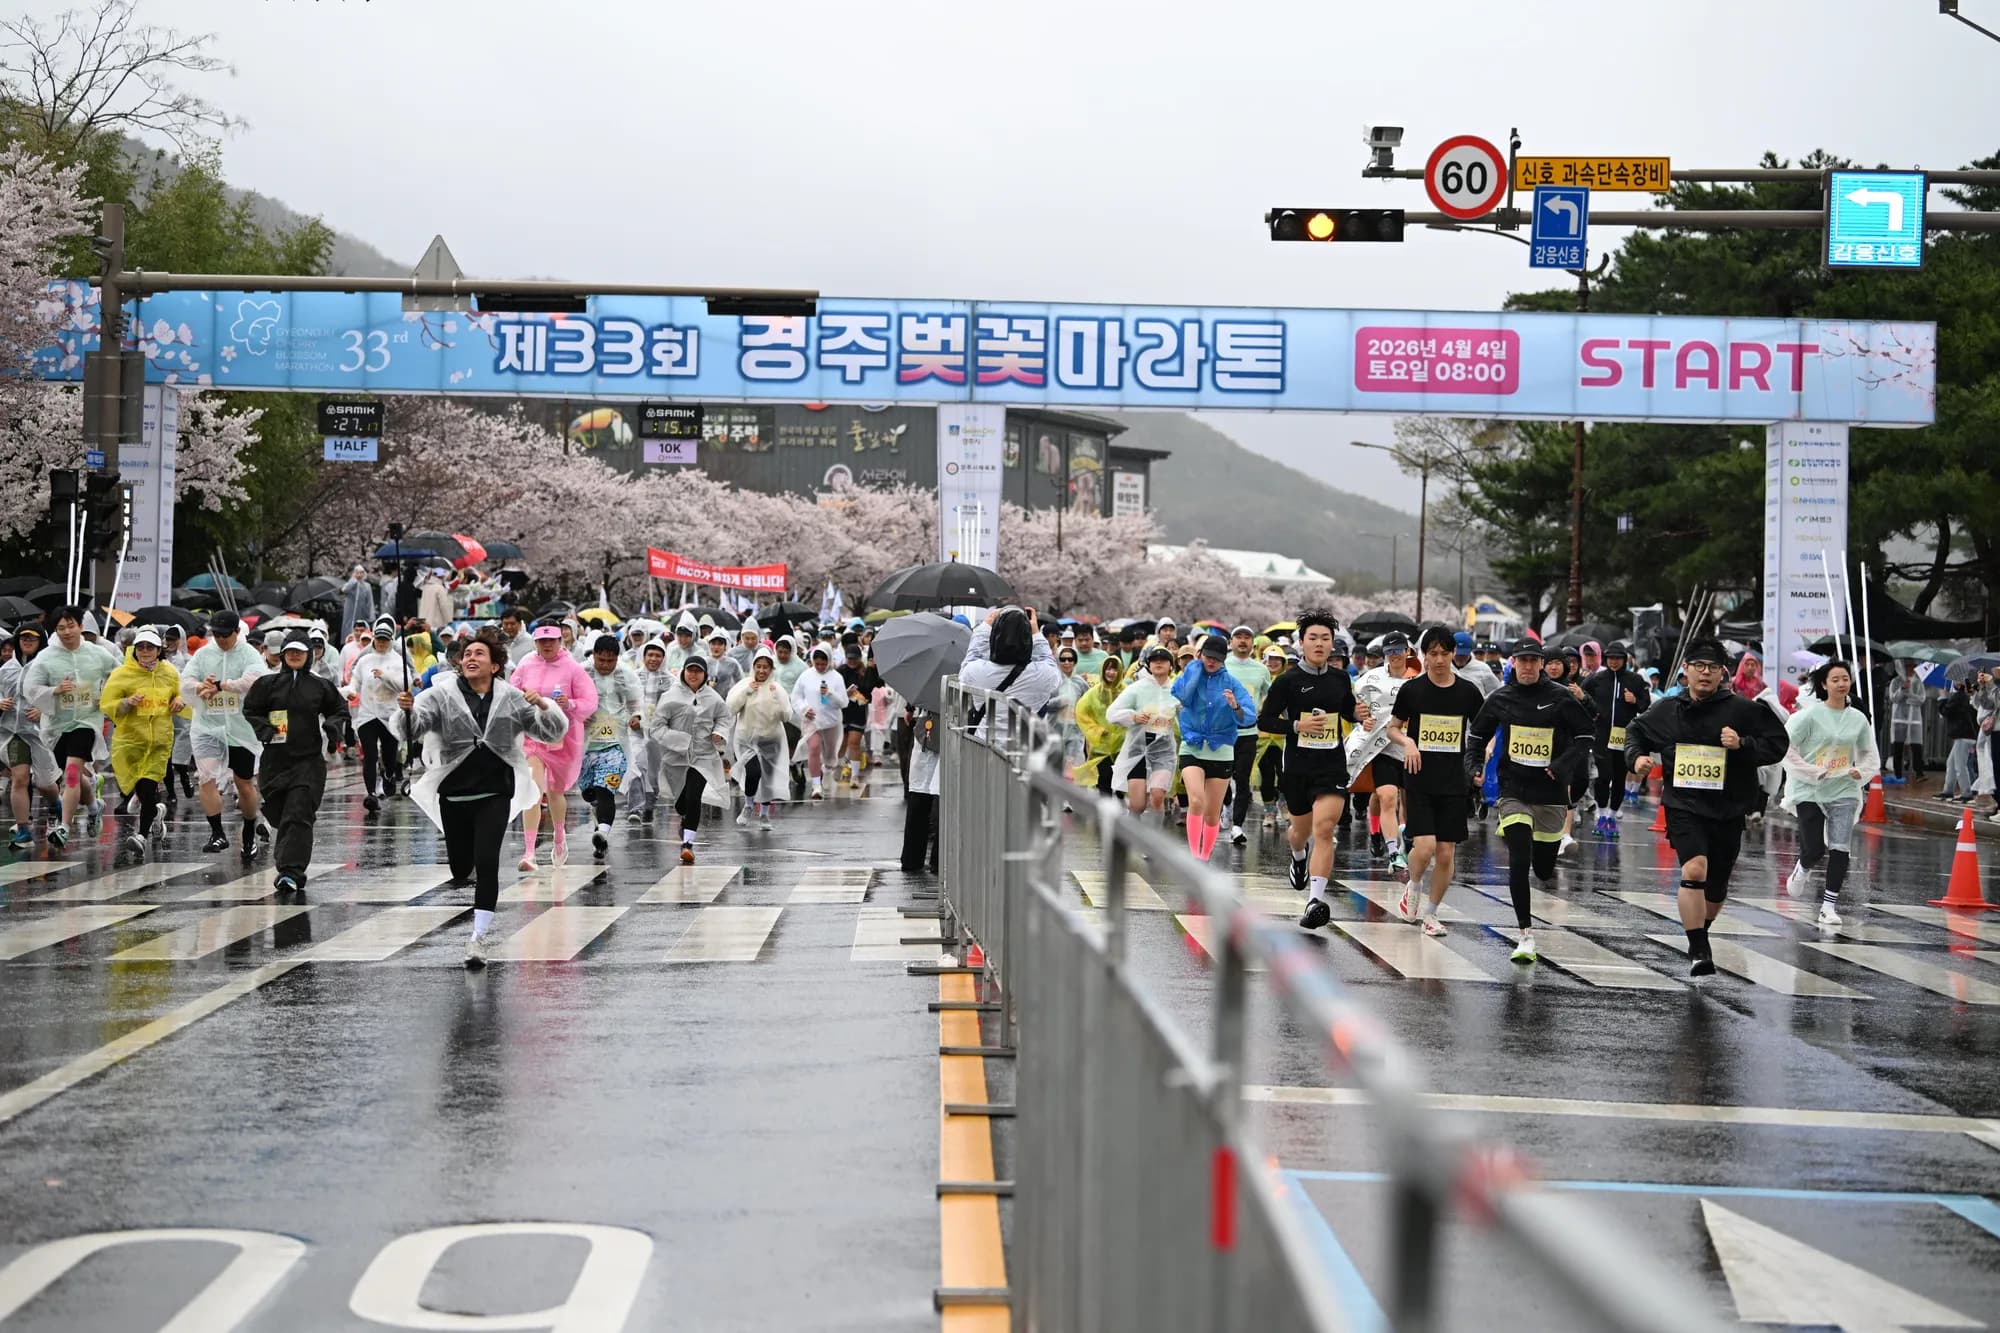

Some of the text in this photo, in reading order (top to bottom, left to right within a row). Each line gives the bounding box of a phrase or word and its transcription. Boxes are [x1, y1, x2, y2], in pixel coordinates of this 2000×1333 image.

[1442, 161, 1487, 194] 60
[1522, 162, 1664, 187] 신호 과속단속장비
[1535, 246, 1580, 265] 감응신호
[1833, 243, 1917, 261] 감응신호
[276, 351, 327, 360] BLOSSOM
[499, 313, 1285, 391] 제33회 경주벚꽃마라톤
[1367, 338, 1507, 361] 2026년 4월 4일
[275, 362, 335, 372] MARATHON
[1367, 360, 1507, 382] 토요일 08:00
[1580, 338, 1820, 392] START
[336, 406, 375, 414] SAMIK
[656, 409, 696, 417] SAMIK
[334, 440, 368, 451] HALF
[660, 443, 681, 454] 10K
[1790, 591, 1827, 599] MALDEN
[208, 696, 235, 707] 3136
[1421, 730, 1460, 743] 30437
[1512, 742, 1550, 757] 31043
[1678, 763, 1721, 778] 30133
